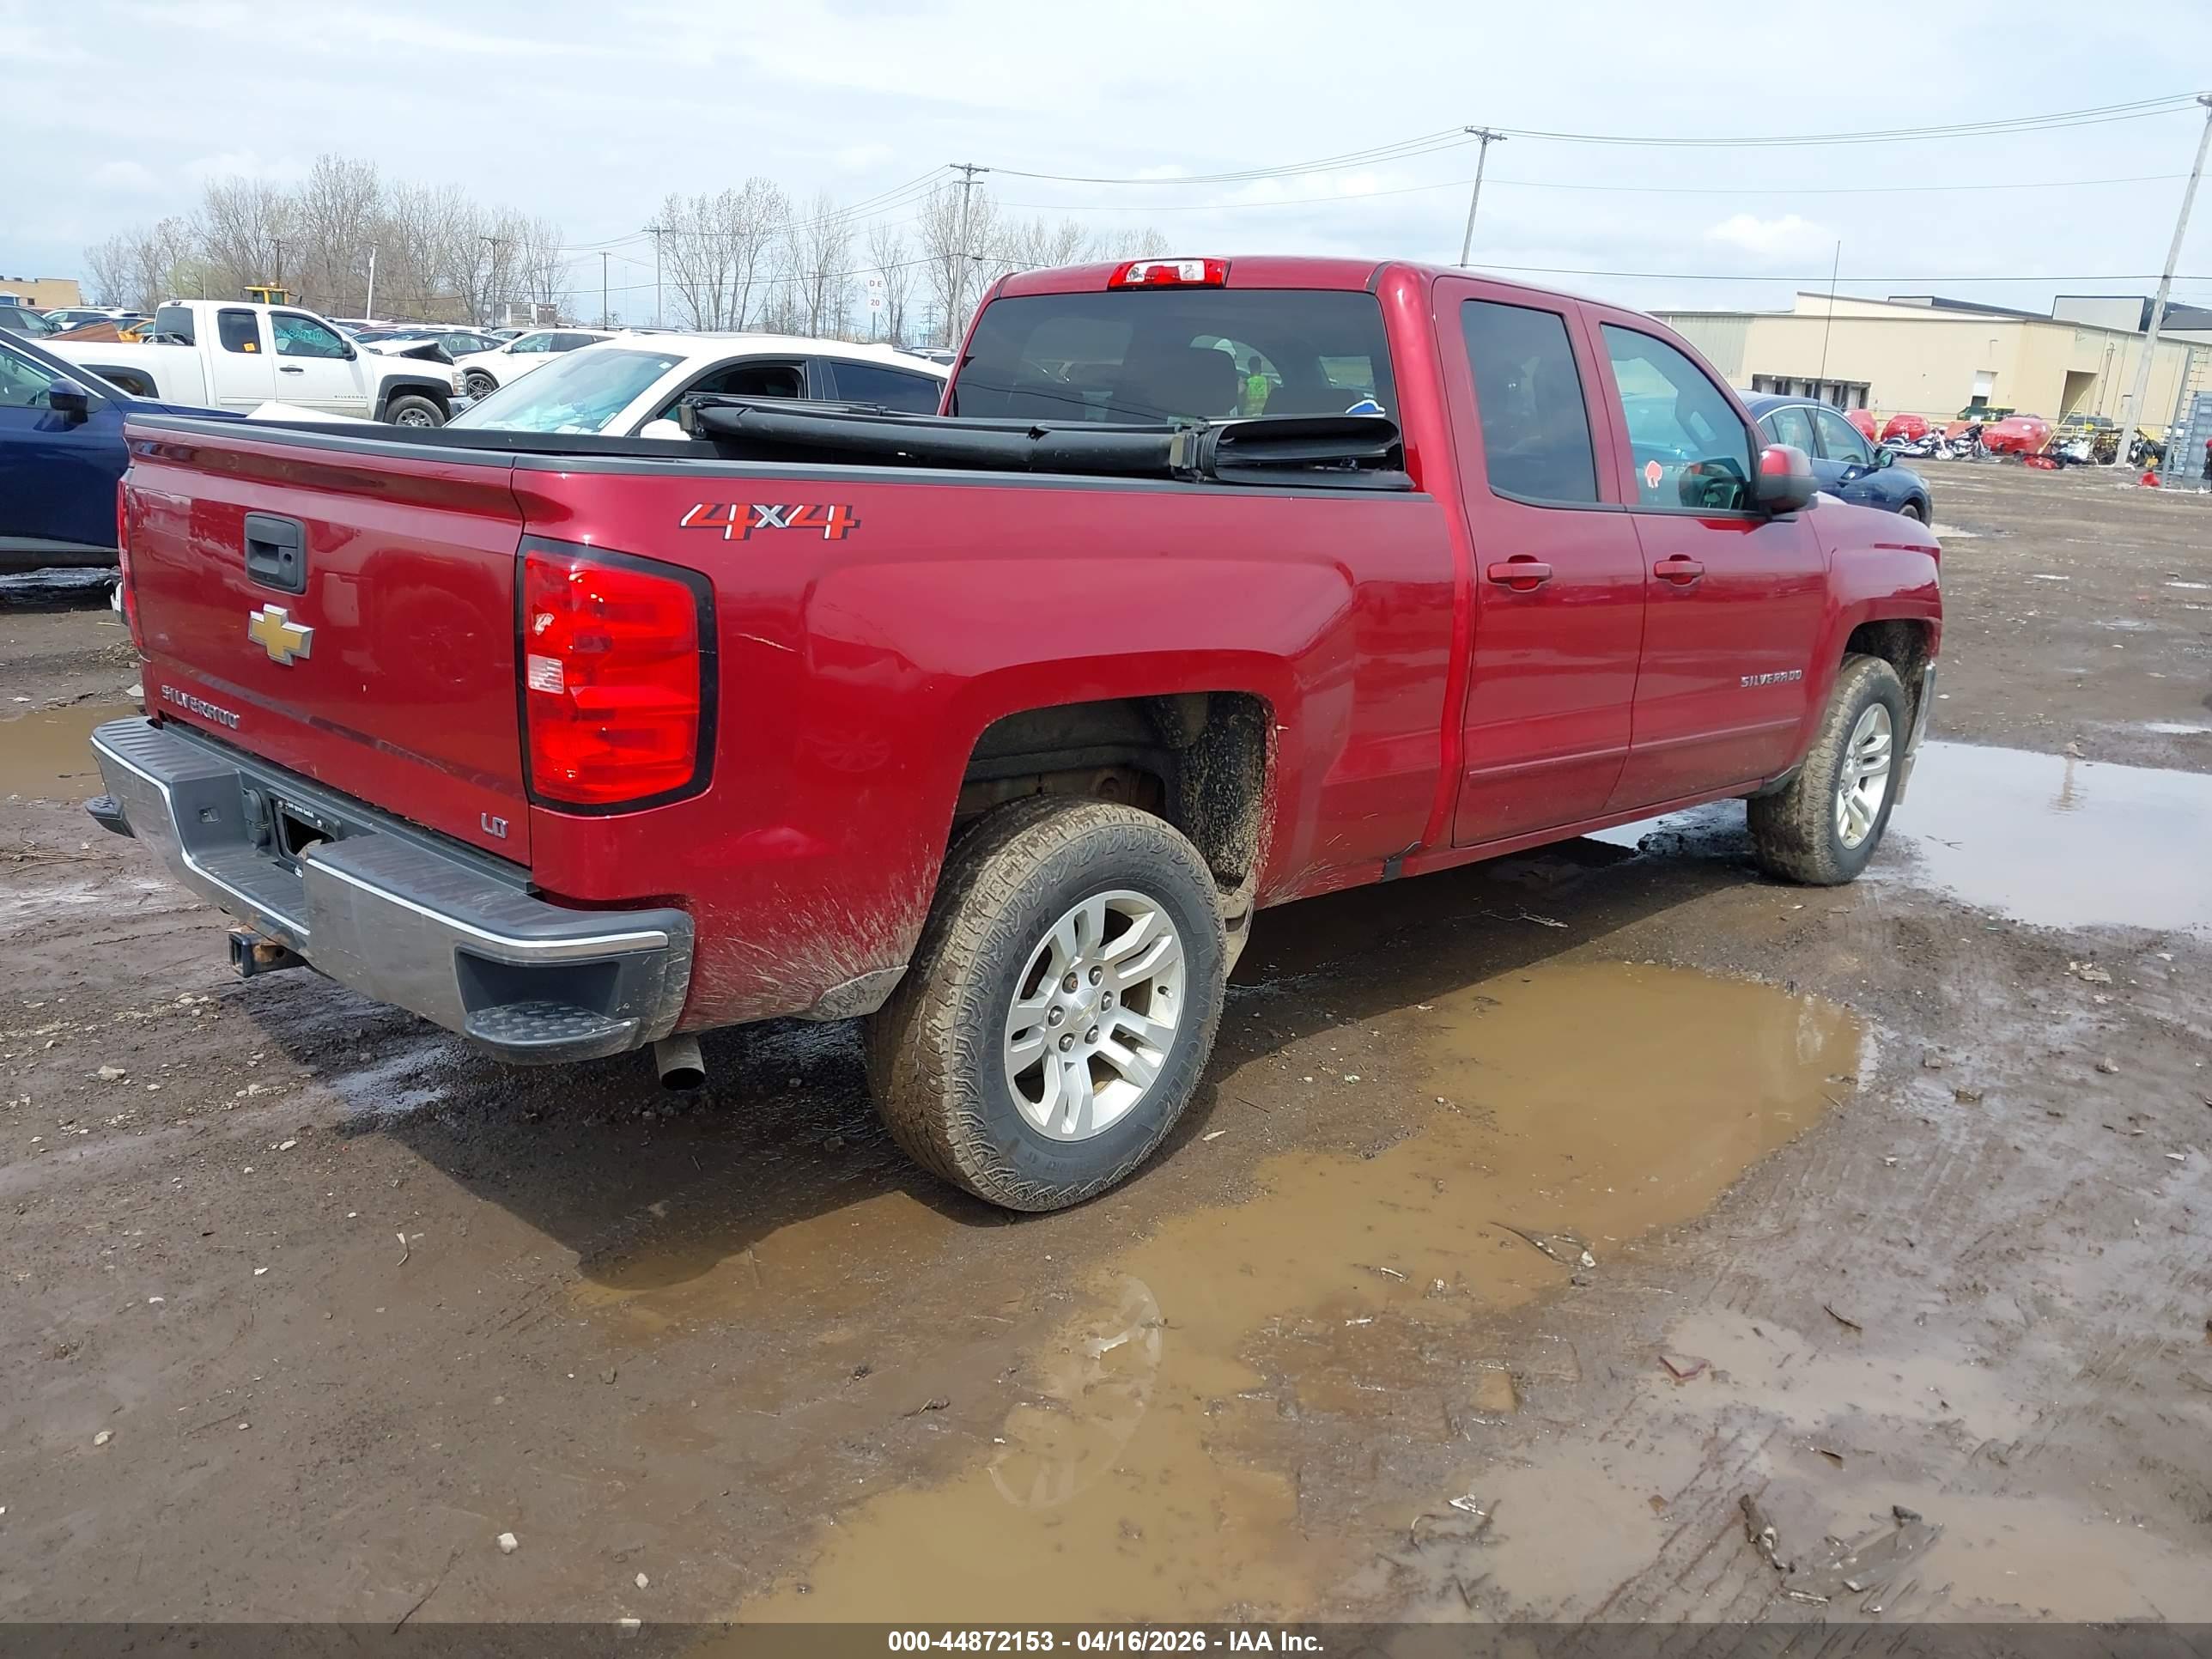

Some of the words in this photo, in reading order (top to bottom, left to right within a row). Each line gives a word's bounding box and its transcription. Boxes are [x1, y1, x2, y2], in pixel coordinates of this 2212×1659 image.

[1740, 669, 1803, 688] SILVERADO
[161, 684, 240, 730] SILVERADO
[481, 812, 508, 839] LT
